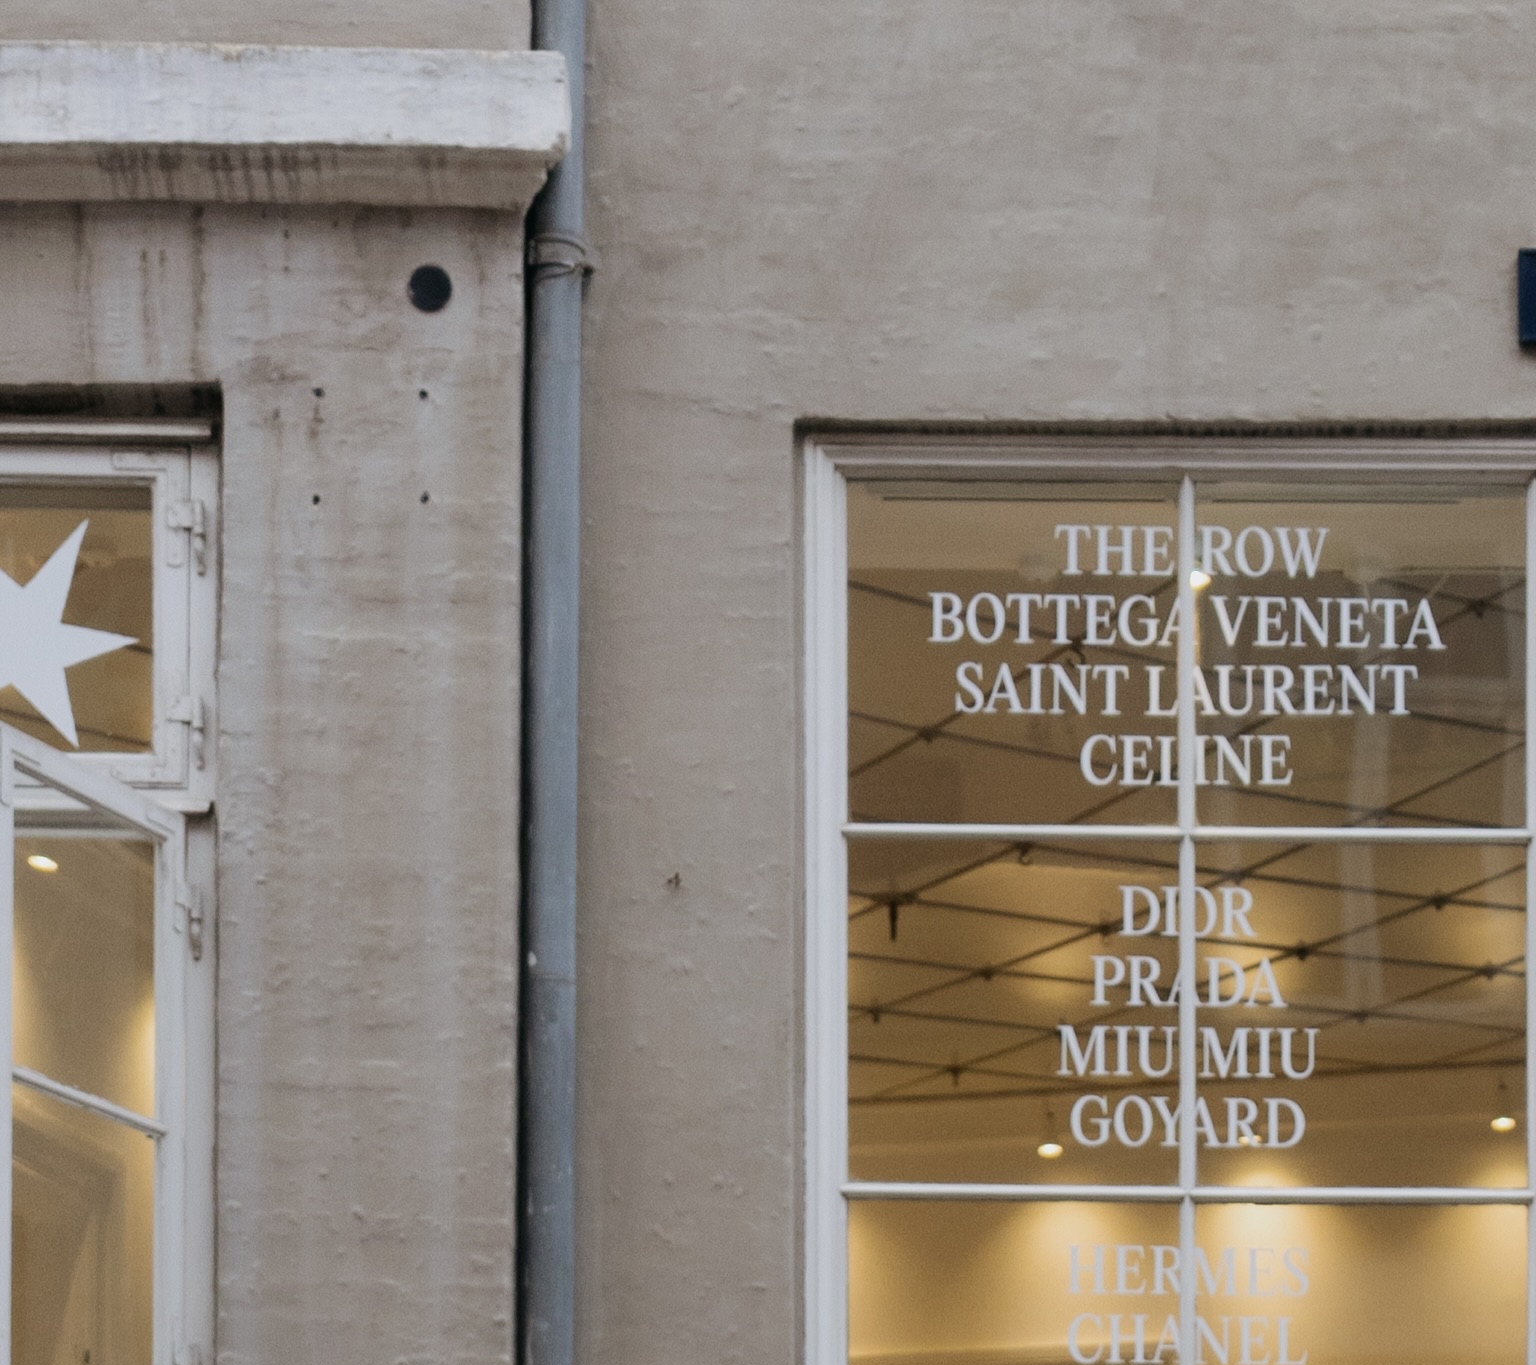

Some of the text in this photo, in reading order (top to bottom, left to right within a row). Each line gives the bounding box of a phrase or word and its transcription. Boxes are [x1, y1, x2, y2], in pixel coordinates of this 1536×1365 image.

[1055, 524, 1329, 578] THE ROW
[1211, 596, 1447, 650] VENETA
[955, 660, 1419, 717] SAINT LAURENT
[1079, 733, 1292, 786] CELINE
[1090, 954, 1288, 1008] PRADA
[1056, 1024, 1320, 1079] MIU MIU
[1070, 1094, 1306, 1149] GOYARD
